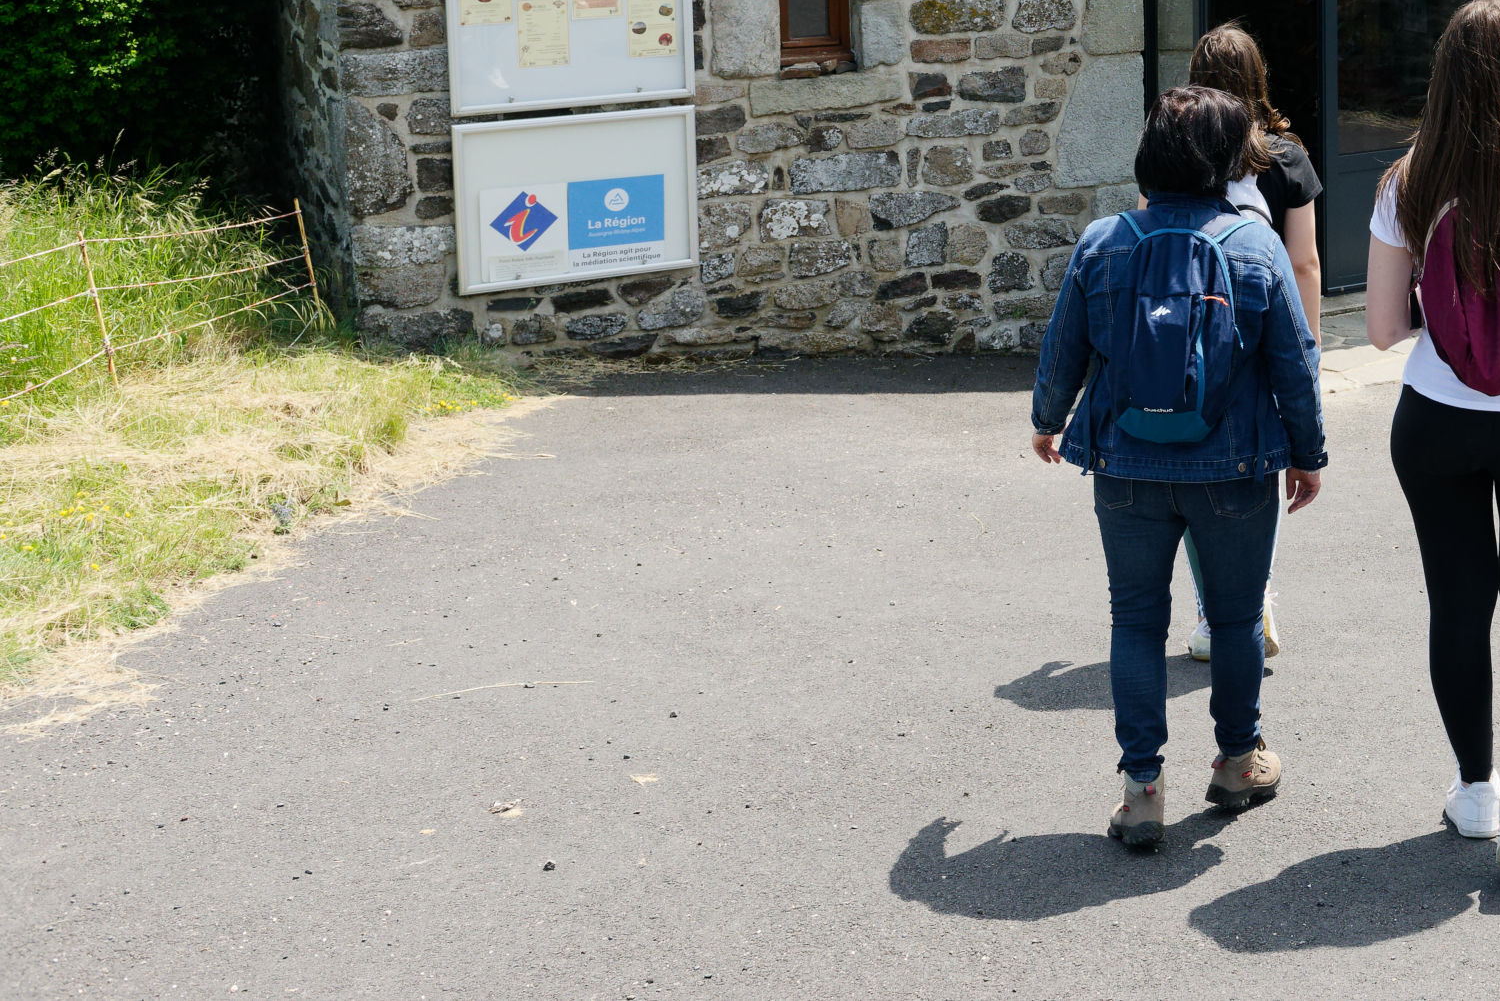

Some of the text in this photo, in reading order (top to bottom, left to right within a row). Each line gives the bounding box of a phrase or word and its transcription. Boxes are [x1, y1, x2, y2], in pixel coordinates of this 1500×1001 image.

[587, 215, 646, 230] La Région
[581, 256, 618, 267] médiation
[619, 252, 662, 263] scientifique
[592, 249, 618, 259] Région
[619, 246, 633, 256] agit
[634, 246, 652, 255] pour
